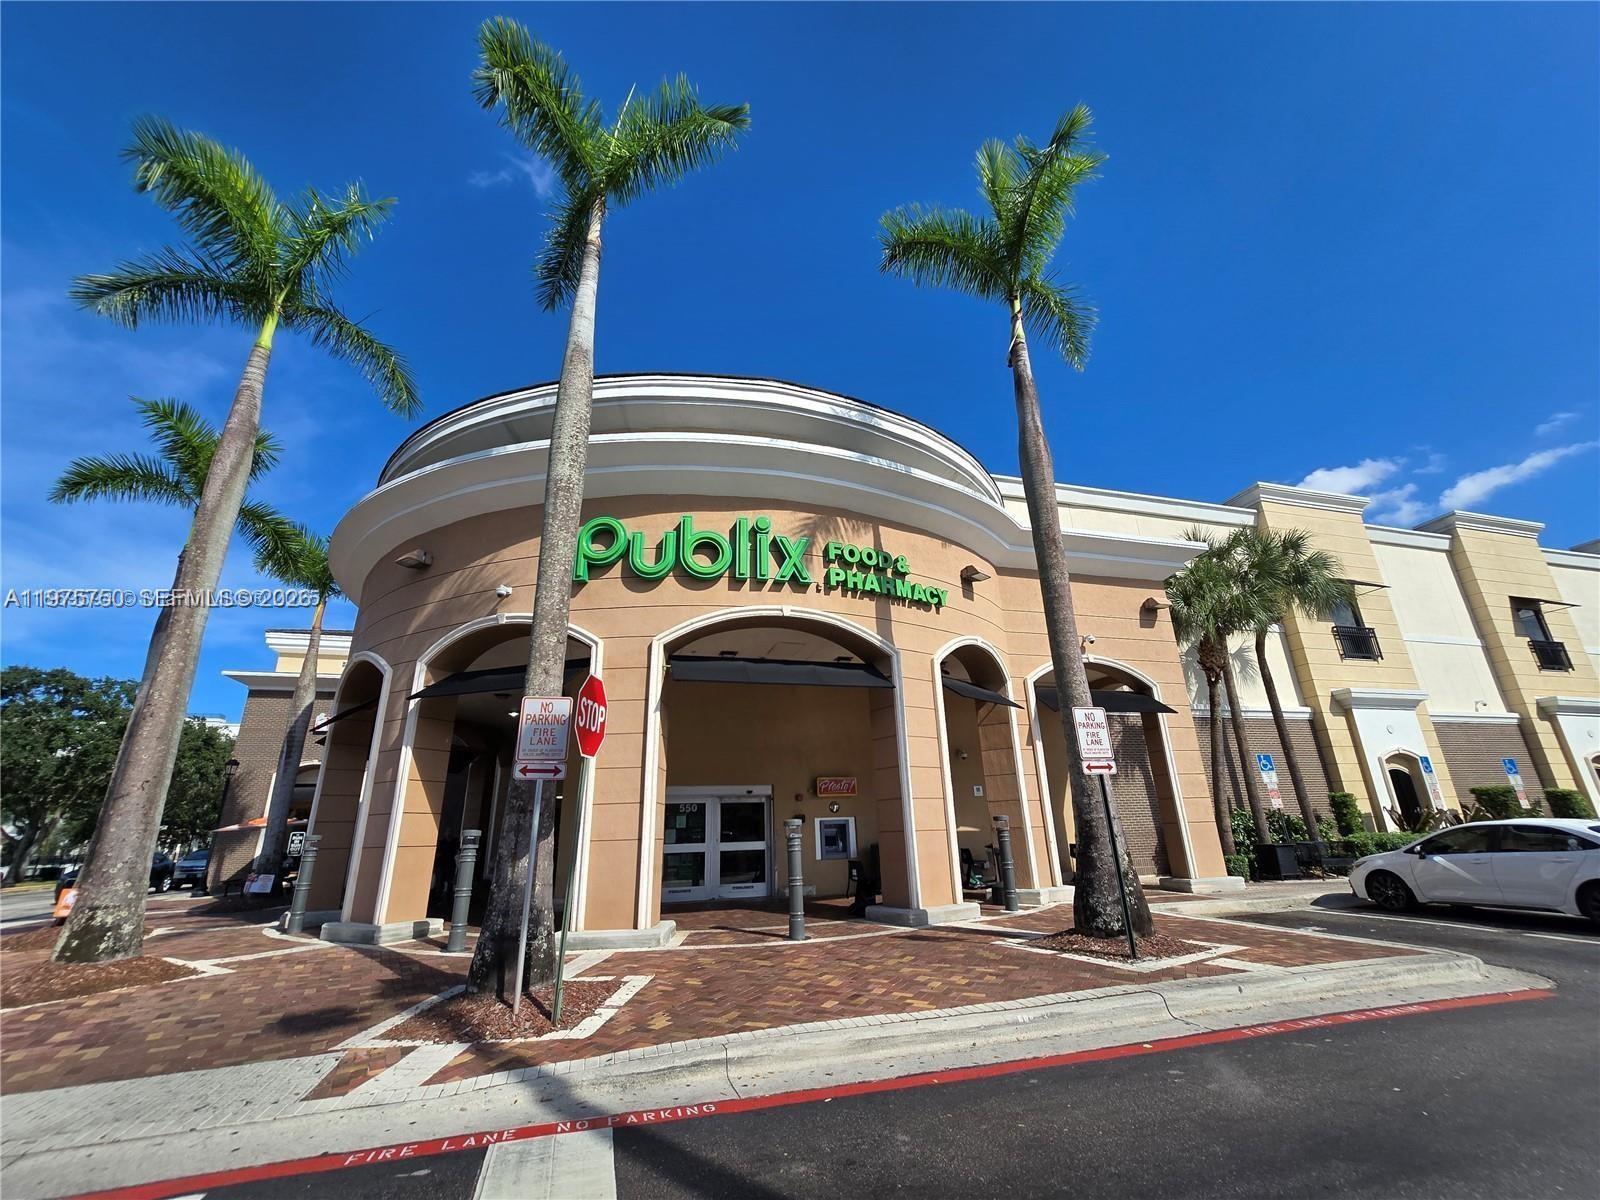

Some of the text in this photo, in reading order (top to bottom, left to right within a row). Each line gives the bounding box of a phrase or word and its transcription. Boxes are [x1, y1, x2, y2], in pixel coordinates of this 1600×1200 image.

[573, 515, 812, 583] Publix
[823, 542, 910, 574] FOOD &
[826, 567, 948, 606] PHARMACY
[540, 702, 554, 713] NO
[525, 714, 567, 726] PARKING
[578, 697, 606, 733] STOP
[1084, 712, 1095, 721] NO
[533, 727, 556, 737] FIRE
[530, 736, 558, 746] LANE
[679, 803, 698, 813] 550
[344, 1104, 716, 1165] FIRE LANE NO PARKING
